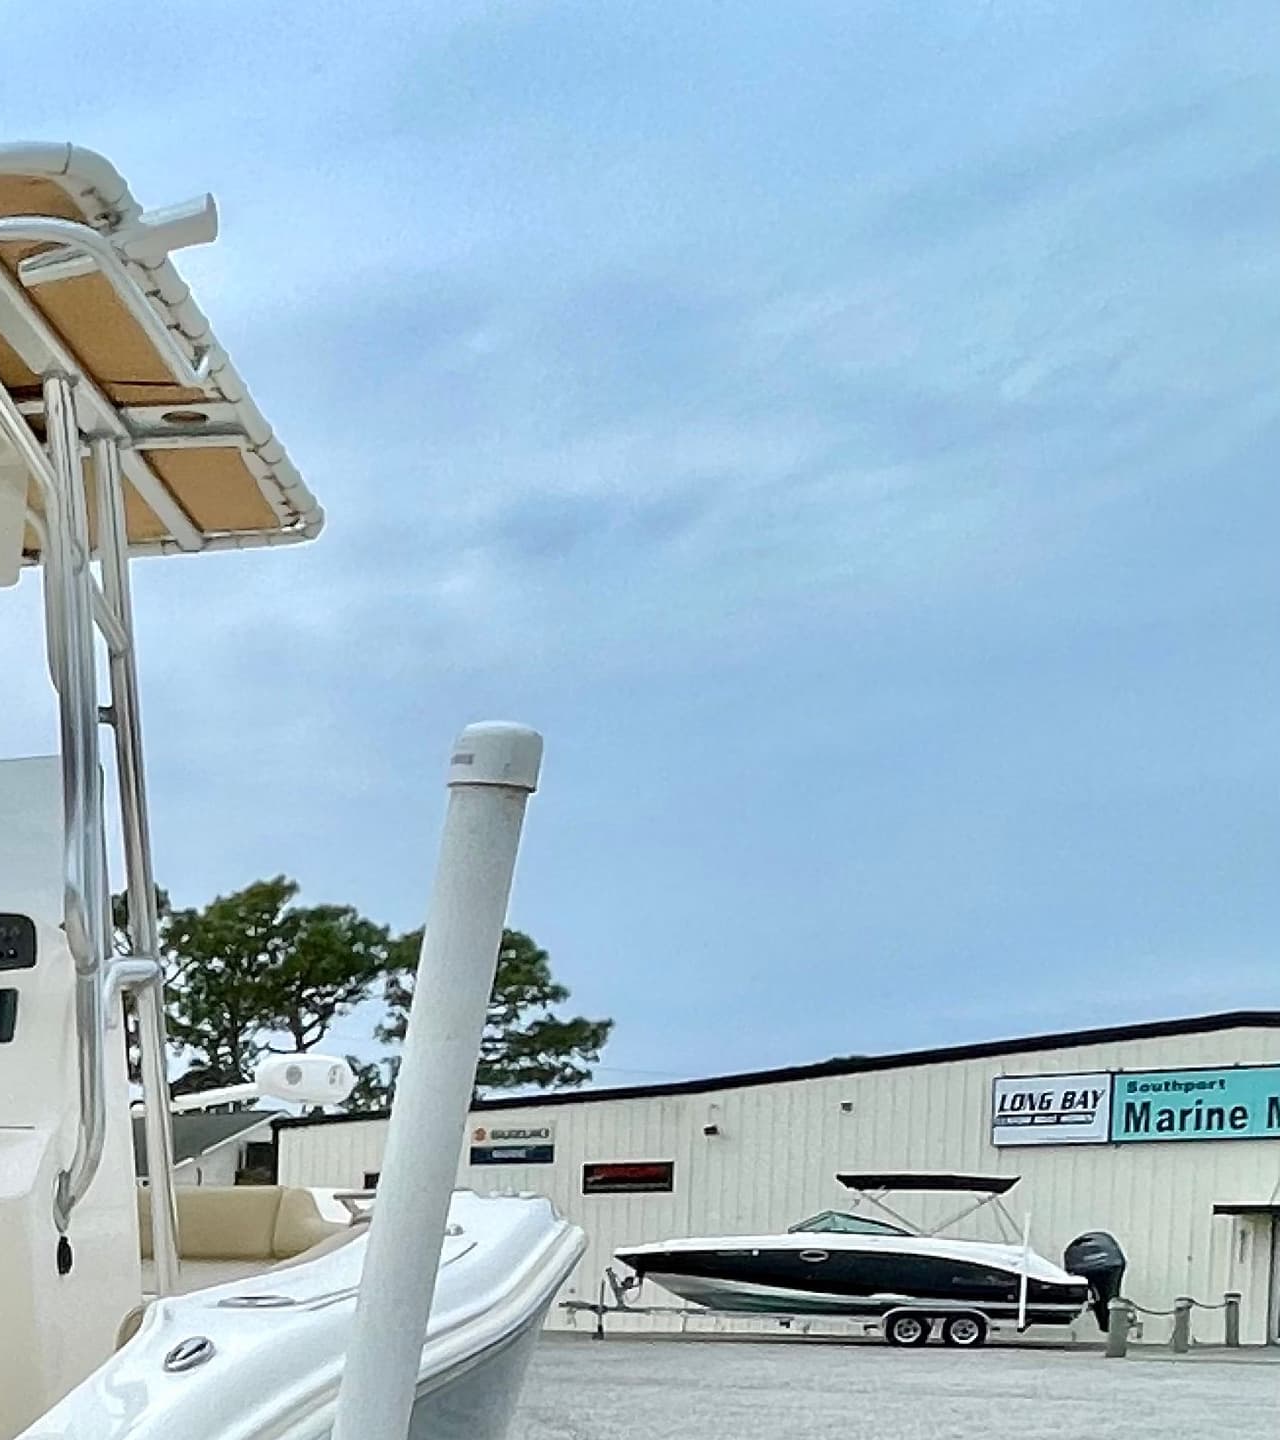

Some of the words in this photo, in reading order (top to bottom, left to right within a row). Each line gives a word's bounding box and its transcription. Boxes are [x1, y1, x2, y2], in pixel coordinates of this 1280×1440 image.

[1126, 1079, 1226, 1094] Southport
[998, 1092, 1054, 1113] LONG
[1061, 1088, 1105, 1111] BAY
[1124, 1098, 1248, 1133] Marine
